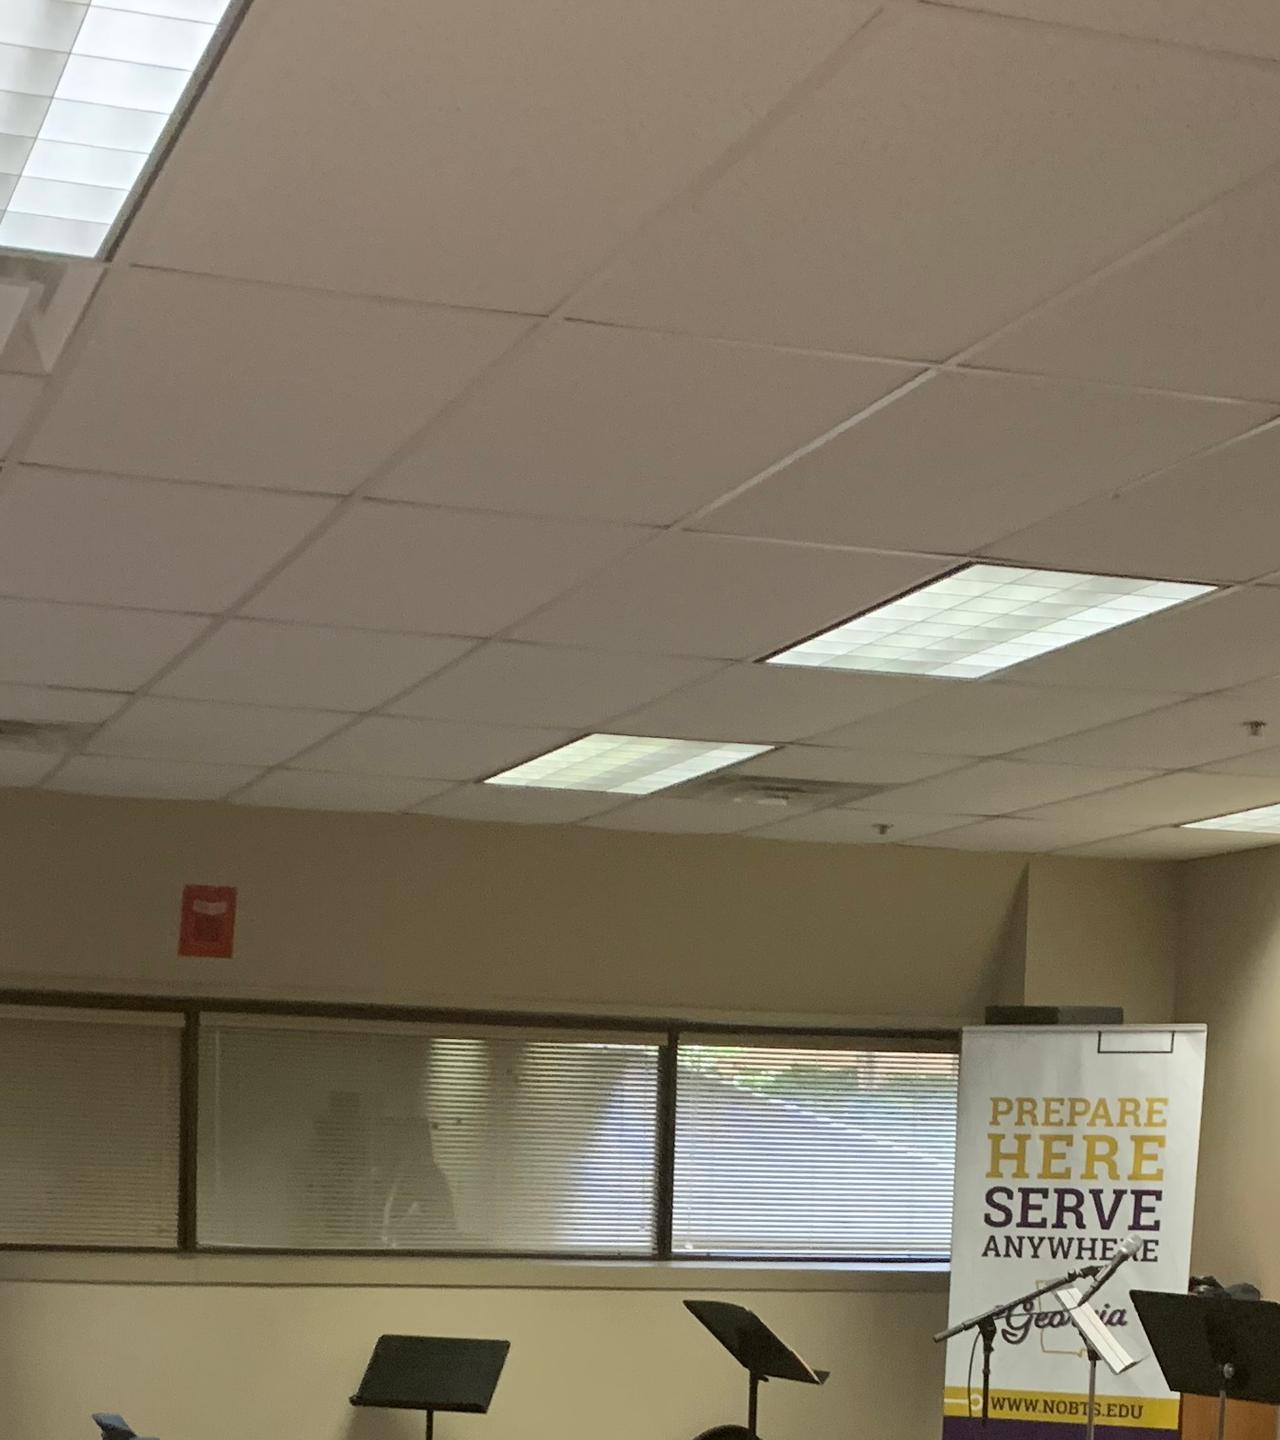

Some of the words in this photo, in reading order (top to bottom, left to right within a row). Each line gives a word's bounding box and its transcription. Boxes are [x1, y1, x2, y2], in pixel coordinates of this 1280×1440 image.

[988, 1096, 1169, 1128] PREPARE
[985, 1133, 1167, 1182] HERE
[983, 1186, 1163, 1232] SERVE
[981, 1235, 1160, 1263] ANYWHEE
[1001, 1299, 1129, 1345] Geoia
[990, 1396, 1144, 1420] WWW.NOBTS.EDU
